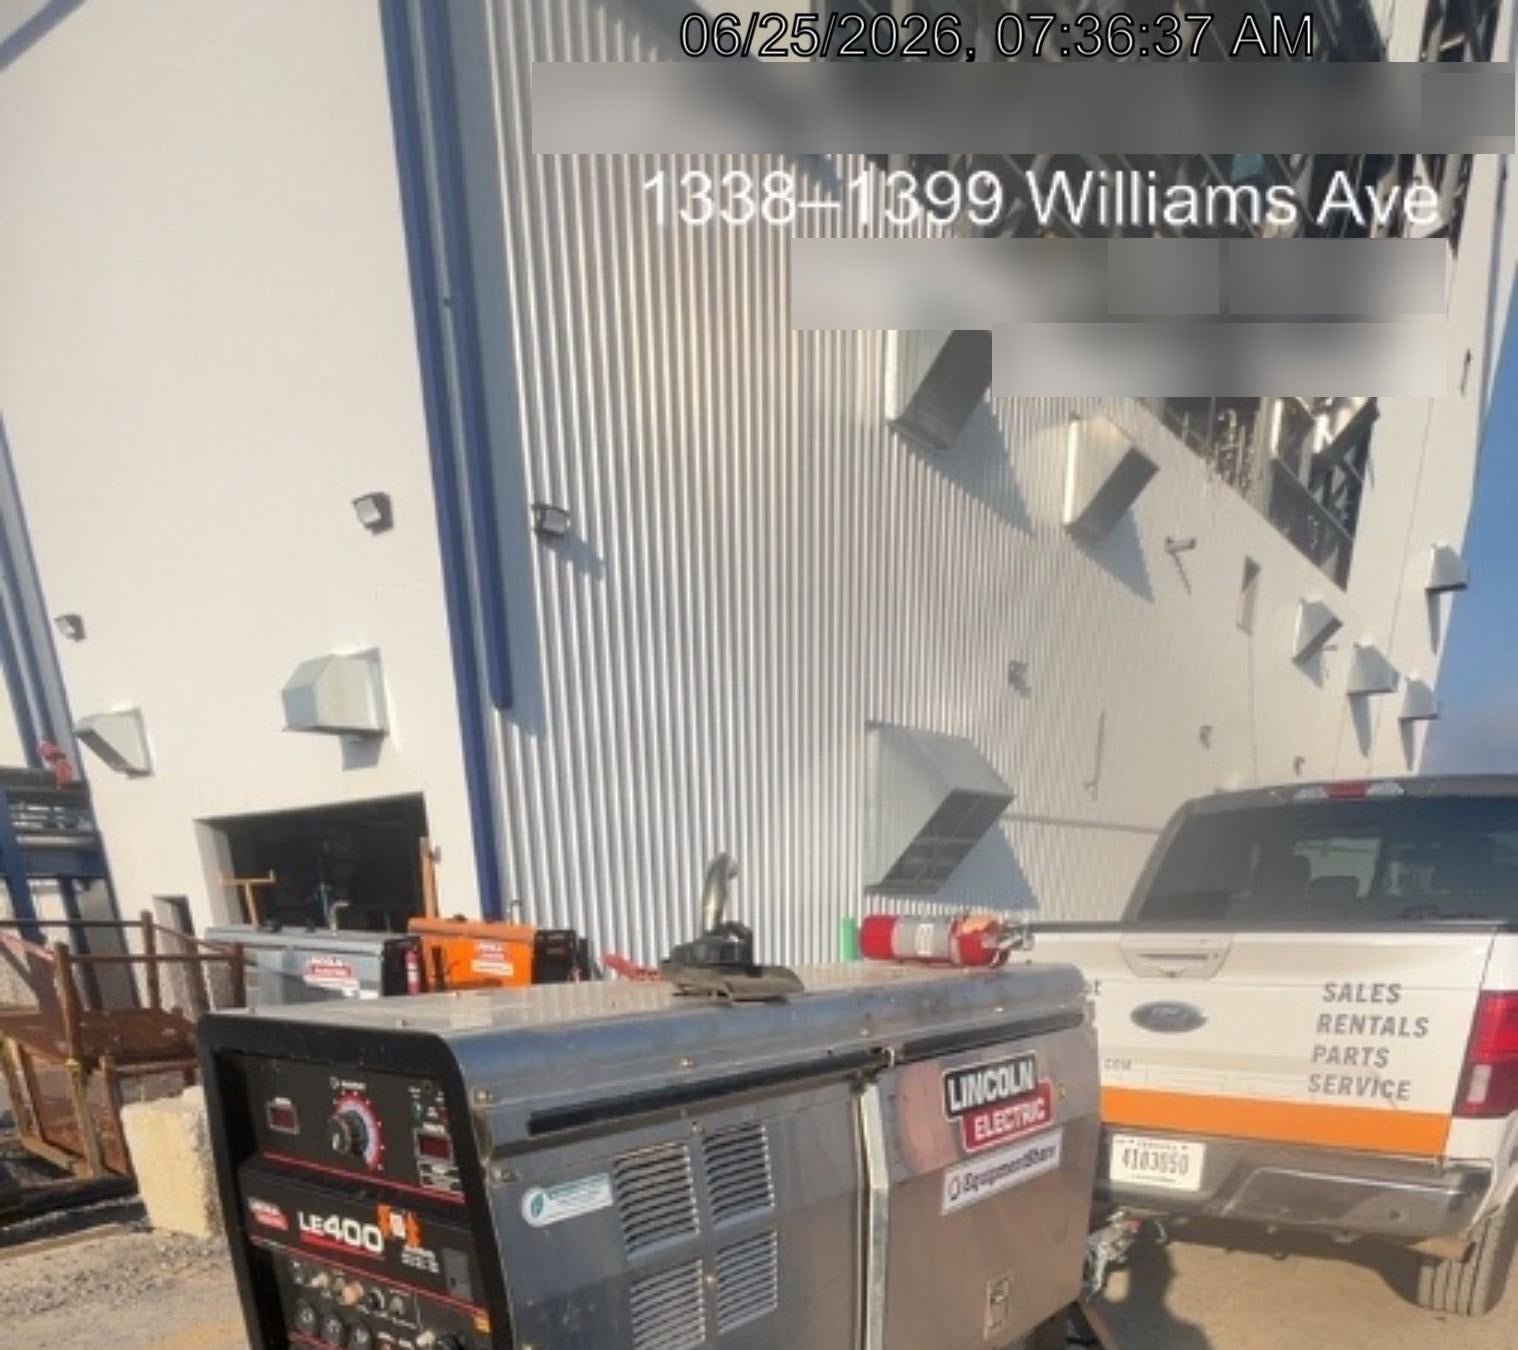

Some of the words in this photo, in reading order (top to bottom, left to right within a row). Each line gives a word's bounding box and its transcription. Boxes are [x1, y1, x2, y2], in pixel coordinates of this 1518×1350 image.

[1322, 982, 1402, 1004] SALES
[1316, 1013, 1429, 1039] RENTALS
[1311, 1045, 1390, 1068] PARTS
[949, 1060, 1035, 1111] LINCOLN
[1307, 1074, 1411, 1101] SERVICE
[974, 1097, 1046, 1140] ELECTRIC
[297, 1211, 385, 1255] LE400
